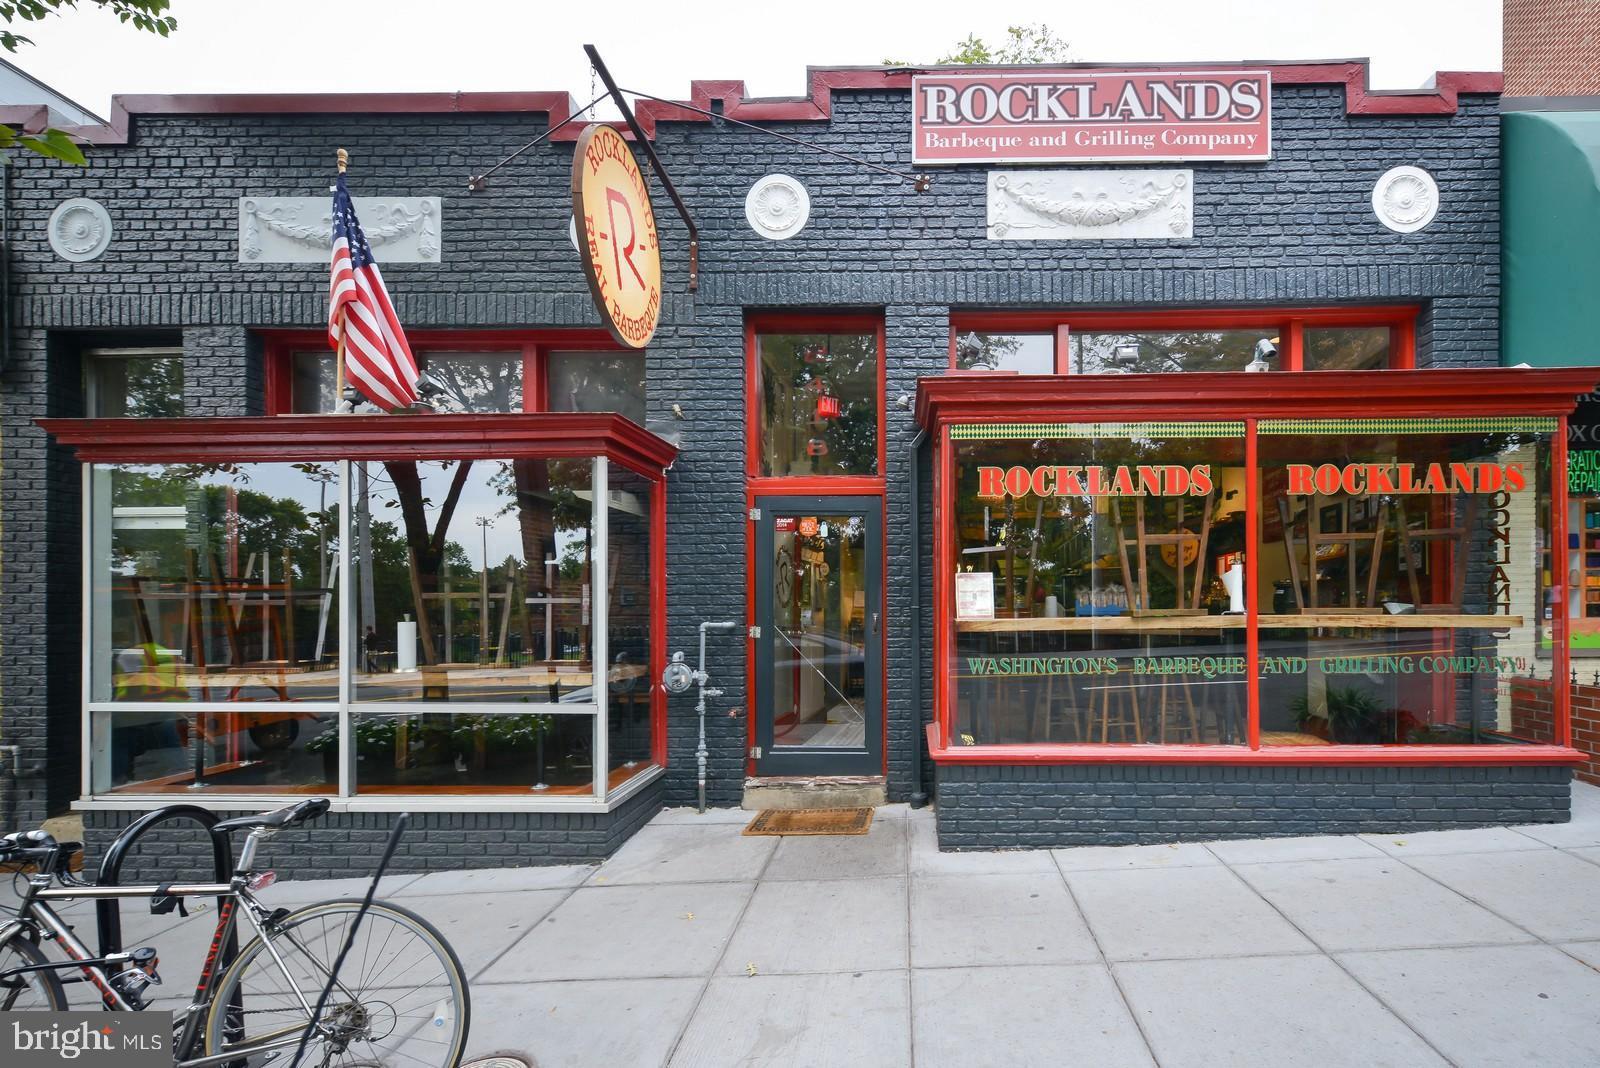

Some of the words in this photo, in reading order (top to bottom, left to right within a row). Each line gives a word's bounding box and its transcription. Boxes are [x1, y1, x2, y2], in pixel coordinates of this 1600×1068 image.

[920, 80, 1262, 124] ROCKLANDS
[925, 132, 1022, 151] Barbeque
[1029, 131, 1067, 147] and
[1074, 130, 1156, 149] Grilling
[1161, 129, 1258, 149] Company
[586, 131, 658, 249] ROCKLANDS
[606, 187, 646, 291] R
[584, 214, 608, 301] REAL
[612, 286, 659, 342] BARBEQUE
[821, 395, 838, 413] EXIT
[977, 464, 1214, 498] ROCKLANDS
[1286, 462, 1526, 496] ROCKLANDS
[1567, 471, 1600, 492] REPAI
[967, 656, 1119, 675] WASHINGTON'S
[1133, 656, 1246, 679] BARBEQUE
[1262, 656, 1308, 674] AND
[1320, 656, 1415, 674] GRILLING
[1419, 655, 1517, 673] COMPANY
